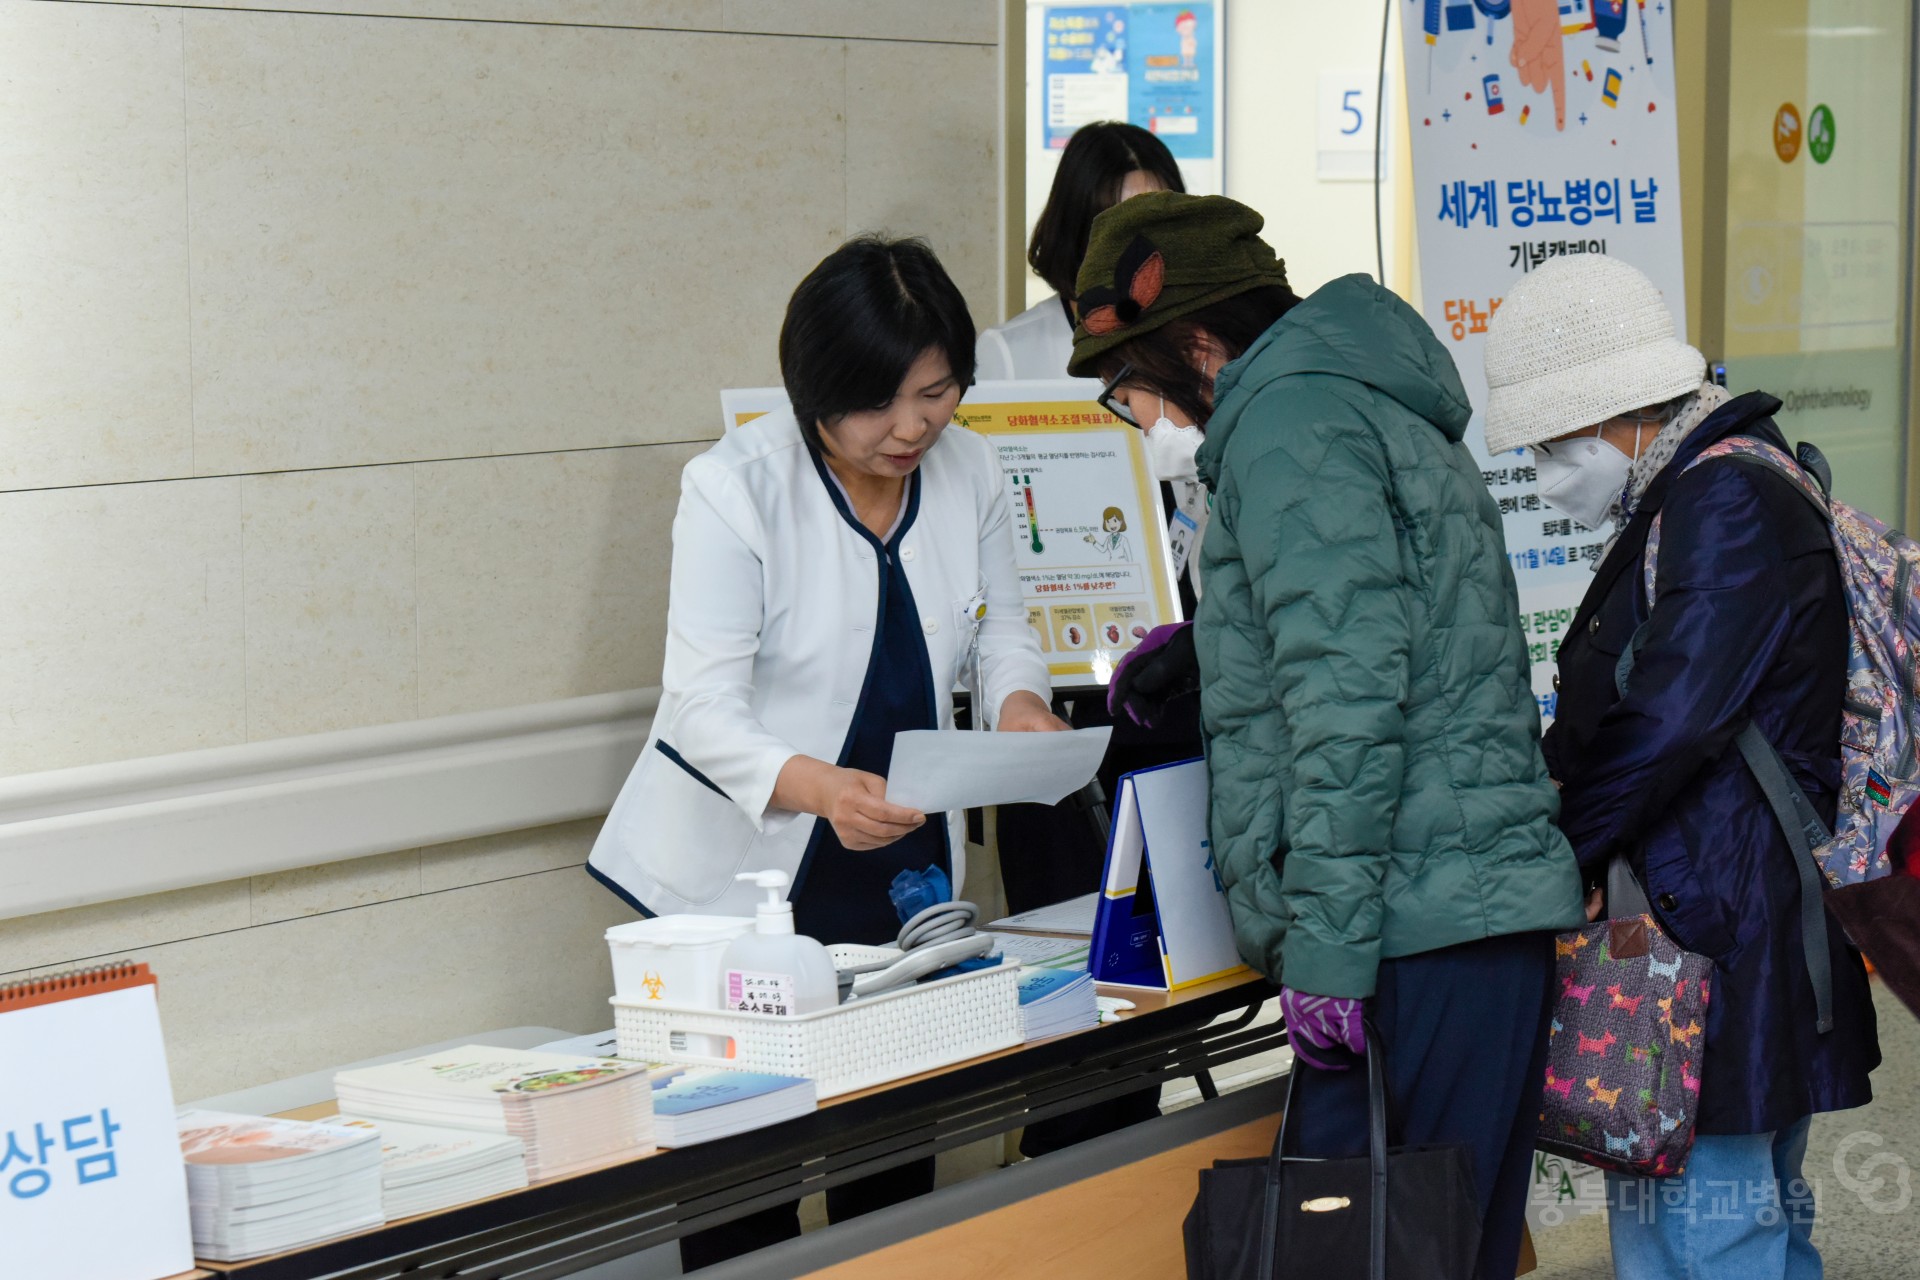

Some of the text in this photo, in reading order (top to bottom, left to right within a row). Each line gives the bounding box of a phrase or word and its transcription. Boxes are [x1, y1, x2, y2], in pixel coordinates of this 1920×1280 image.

[1341, 90, 1362, 134] 5
[1438, 177, 1659, 228] 세계 당뇨병의 날
[1785, 385, 1873, 415] Ophthalmology
[1542, 518, 1571, 537] 퇴치를
[1515, 548, 1540, 569] 11월
[1542, 545, 1566, 567] 14일
[1533, 607, 1572, 634] 관심이
[0, 1107, 121, 1200] 상담
